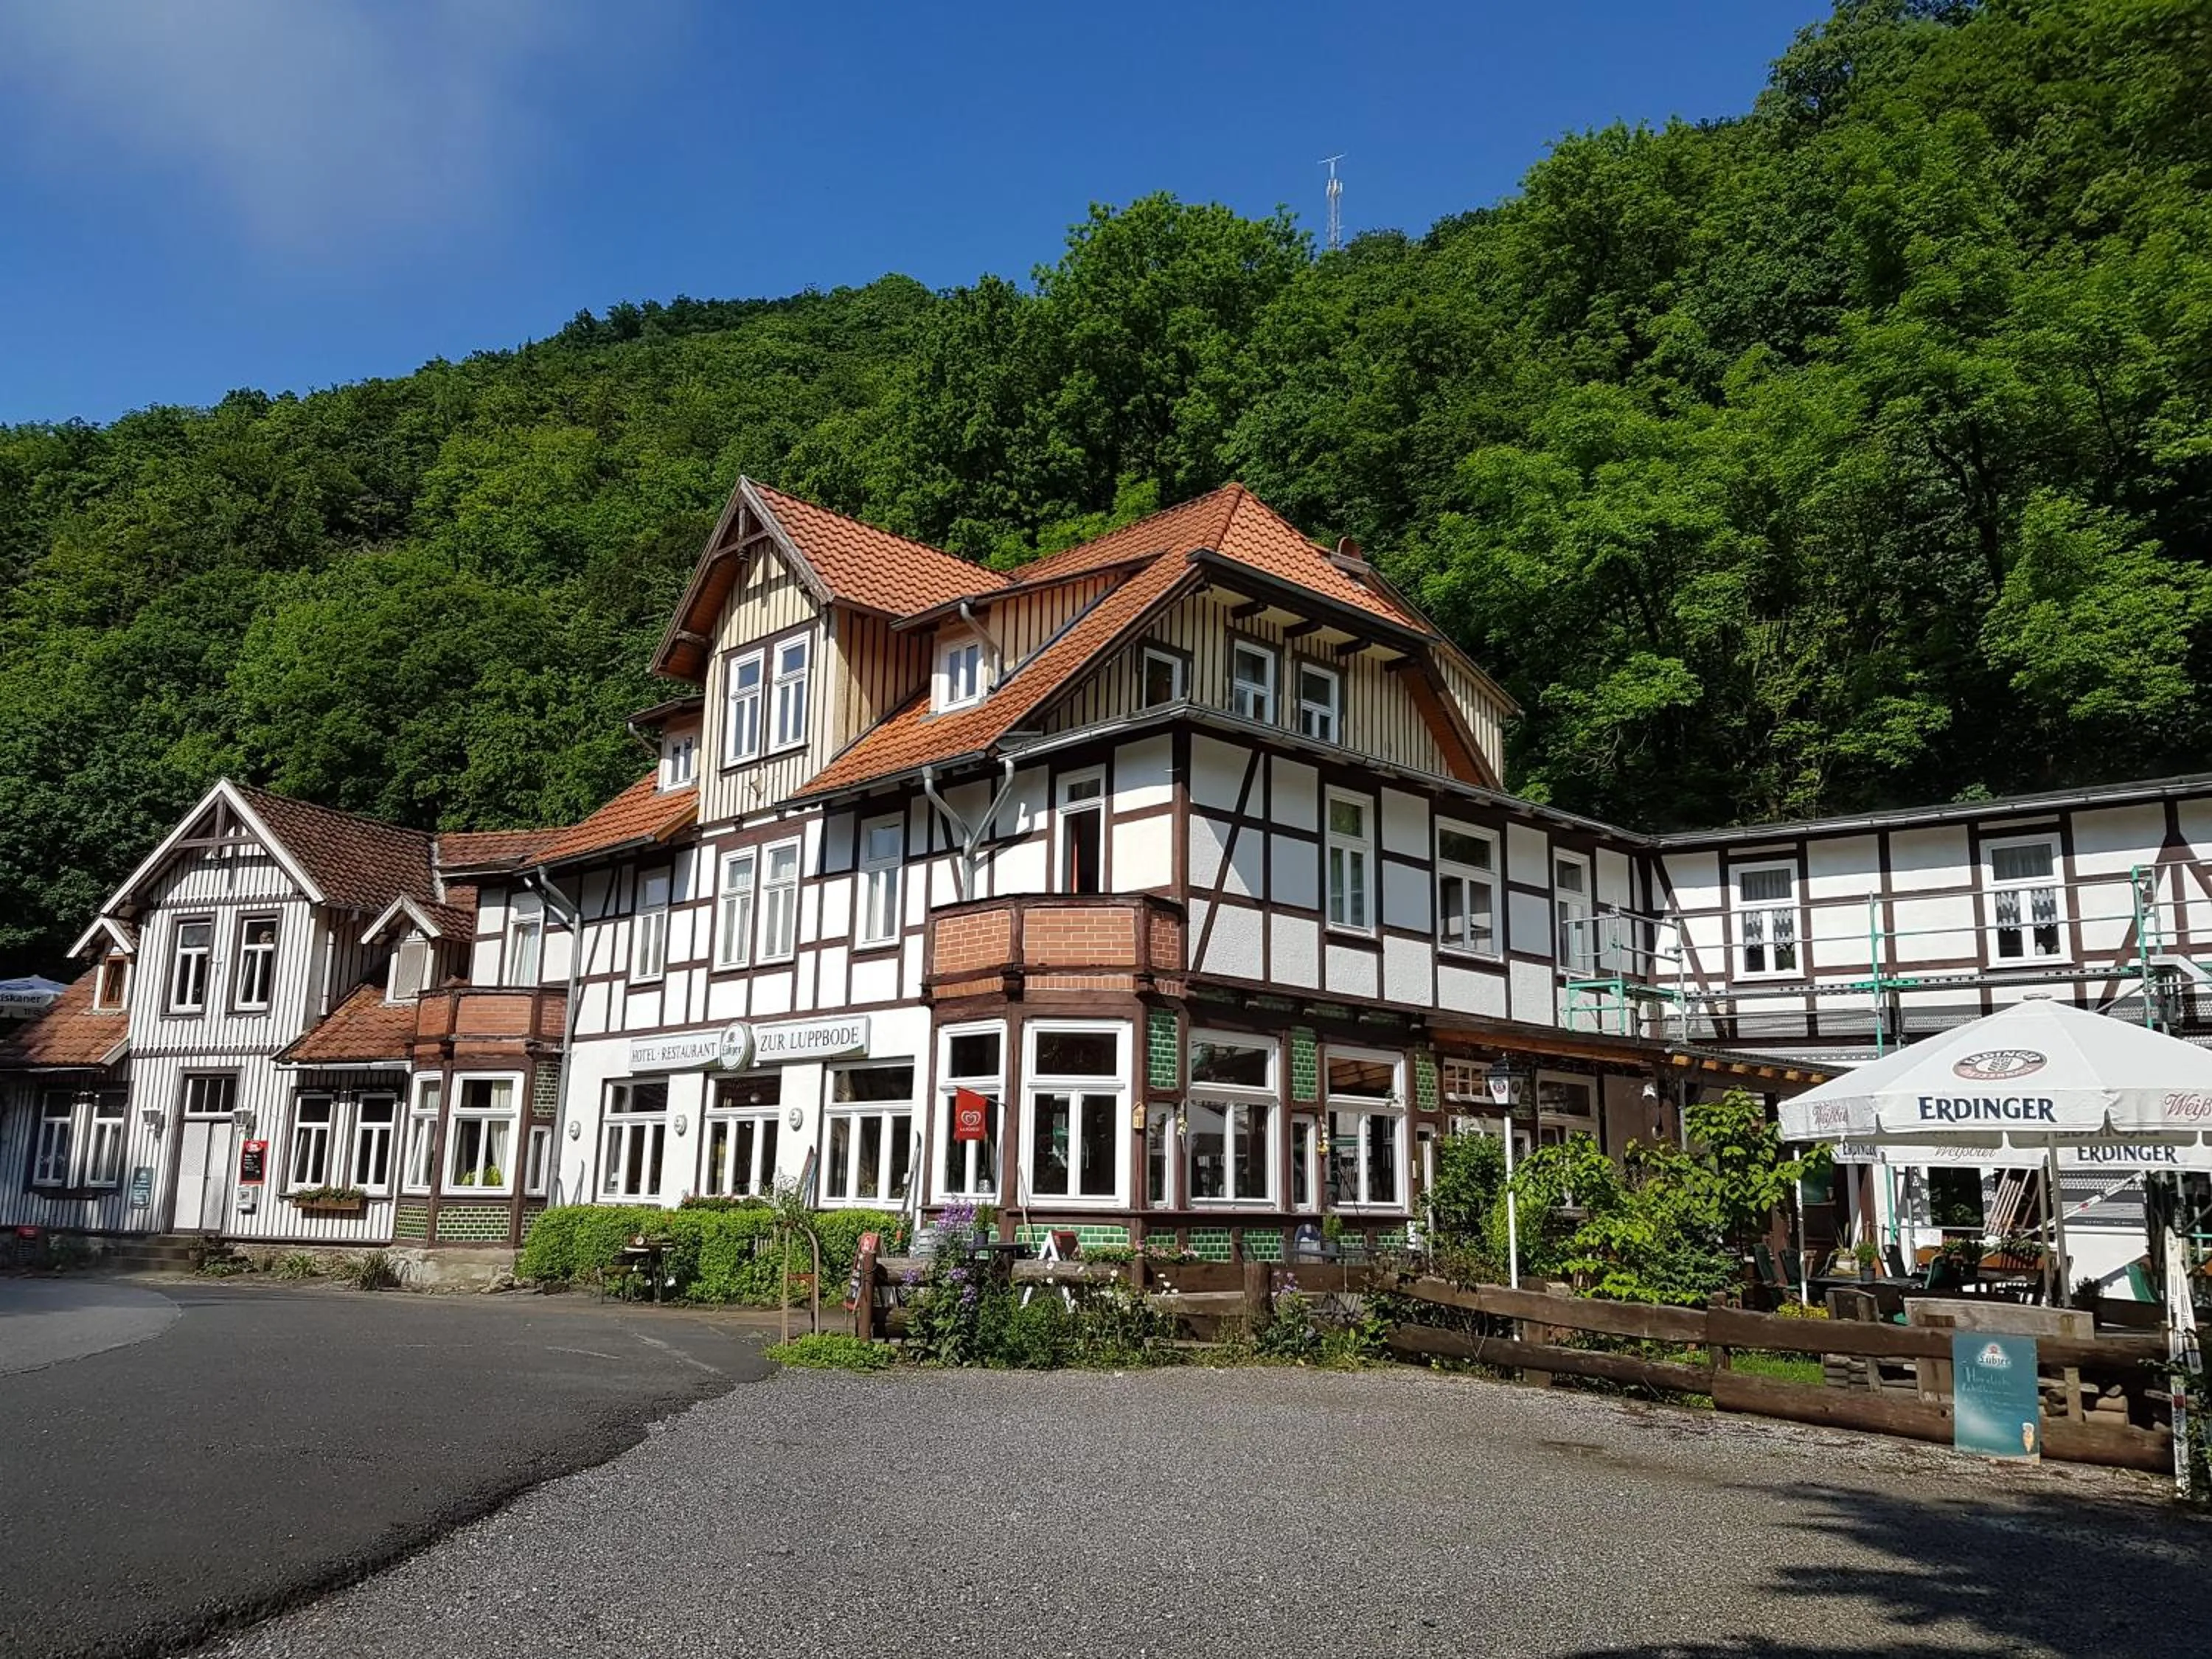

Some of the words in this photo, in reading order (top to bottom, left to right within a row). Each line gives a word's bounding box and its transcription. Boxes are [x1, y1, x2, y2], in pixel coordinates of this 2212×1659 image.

[760, 1033, 785, 1052] ZUR
[790, 1026, 859, 1049] LUPPBODE
[632, 1048, 655, 1062] HOTEL
[661, 1042, 716, 1060] RESTAURANT
[1918, 1096, 2059, 1123] ERDINGER
[2077, 1145, 2179, 1164] ERDINGER
